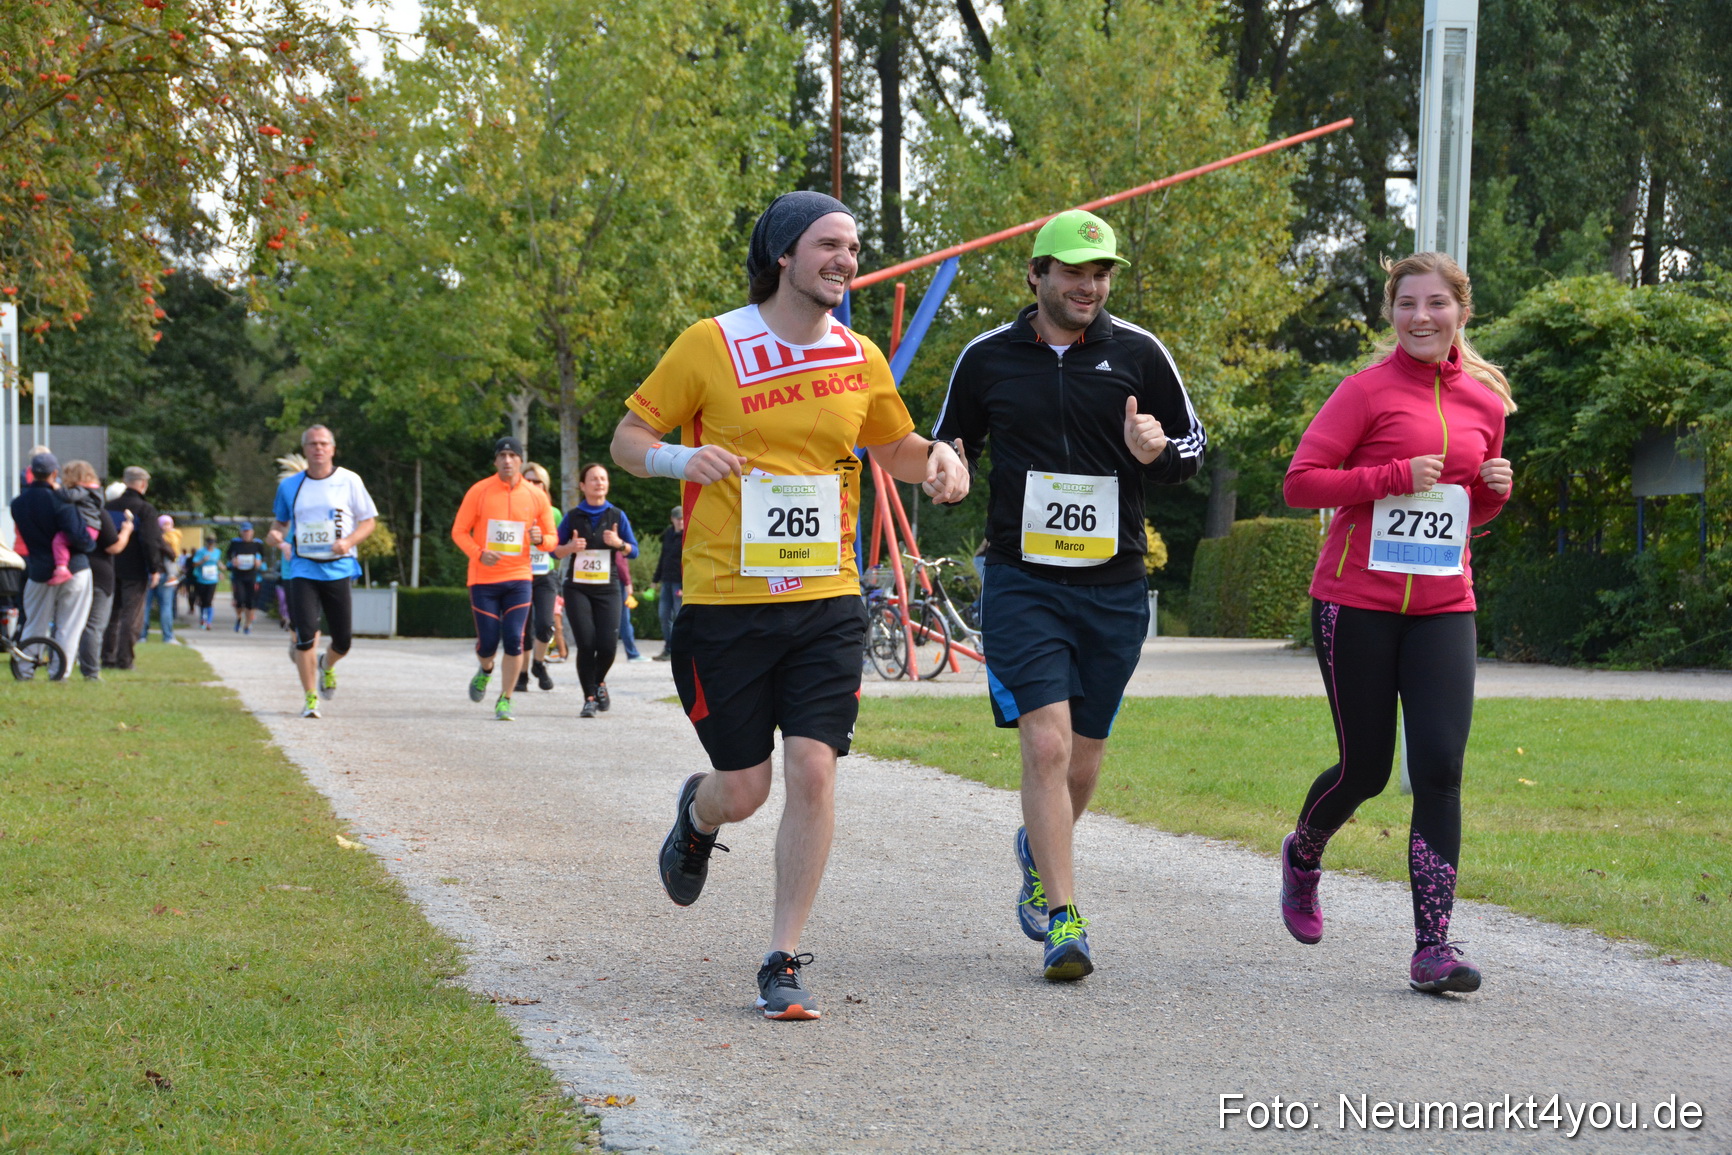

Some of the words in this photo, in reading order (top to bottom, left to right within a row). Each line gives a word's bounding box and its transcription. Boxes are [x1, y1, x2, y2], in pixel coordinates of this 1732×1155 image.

[741, 384, 805, 414] MAX
[811, 373, 869, 398] BÖGL
[783, 485, 816, 493] BOCK
[1062, 483, 1093, 493] BOCK
[1414, 491, 1444, 500] BOCK
[767, 507, 820, 537] 265
[1045, 502, 1097, 532] 266
[1387, 509, 1453, 540] 2732
[302, 531, 329, 544] 2132
[495, 531, 515, 543] 305
[1055, 540, 1085, 551] Marco
[779, 548, 810, 559] Daniel
[1387, 543, 1437, 564] HEIDI
[583, 560, 602, 571] 243
